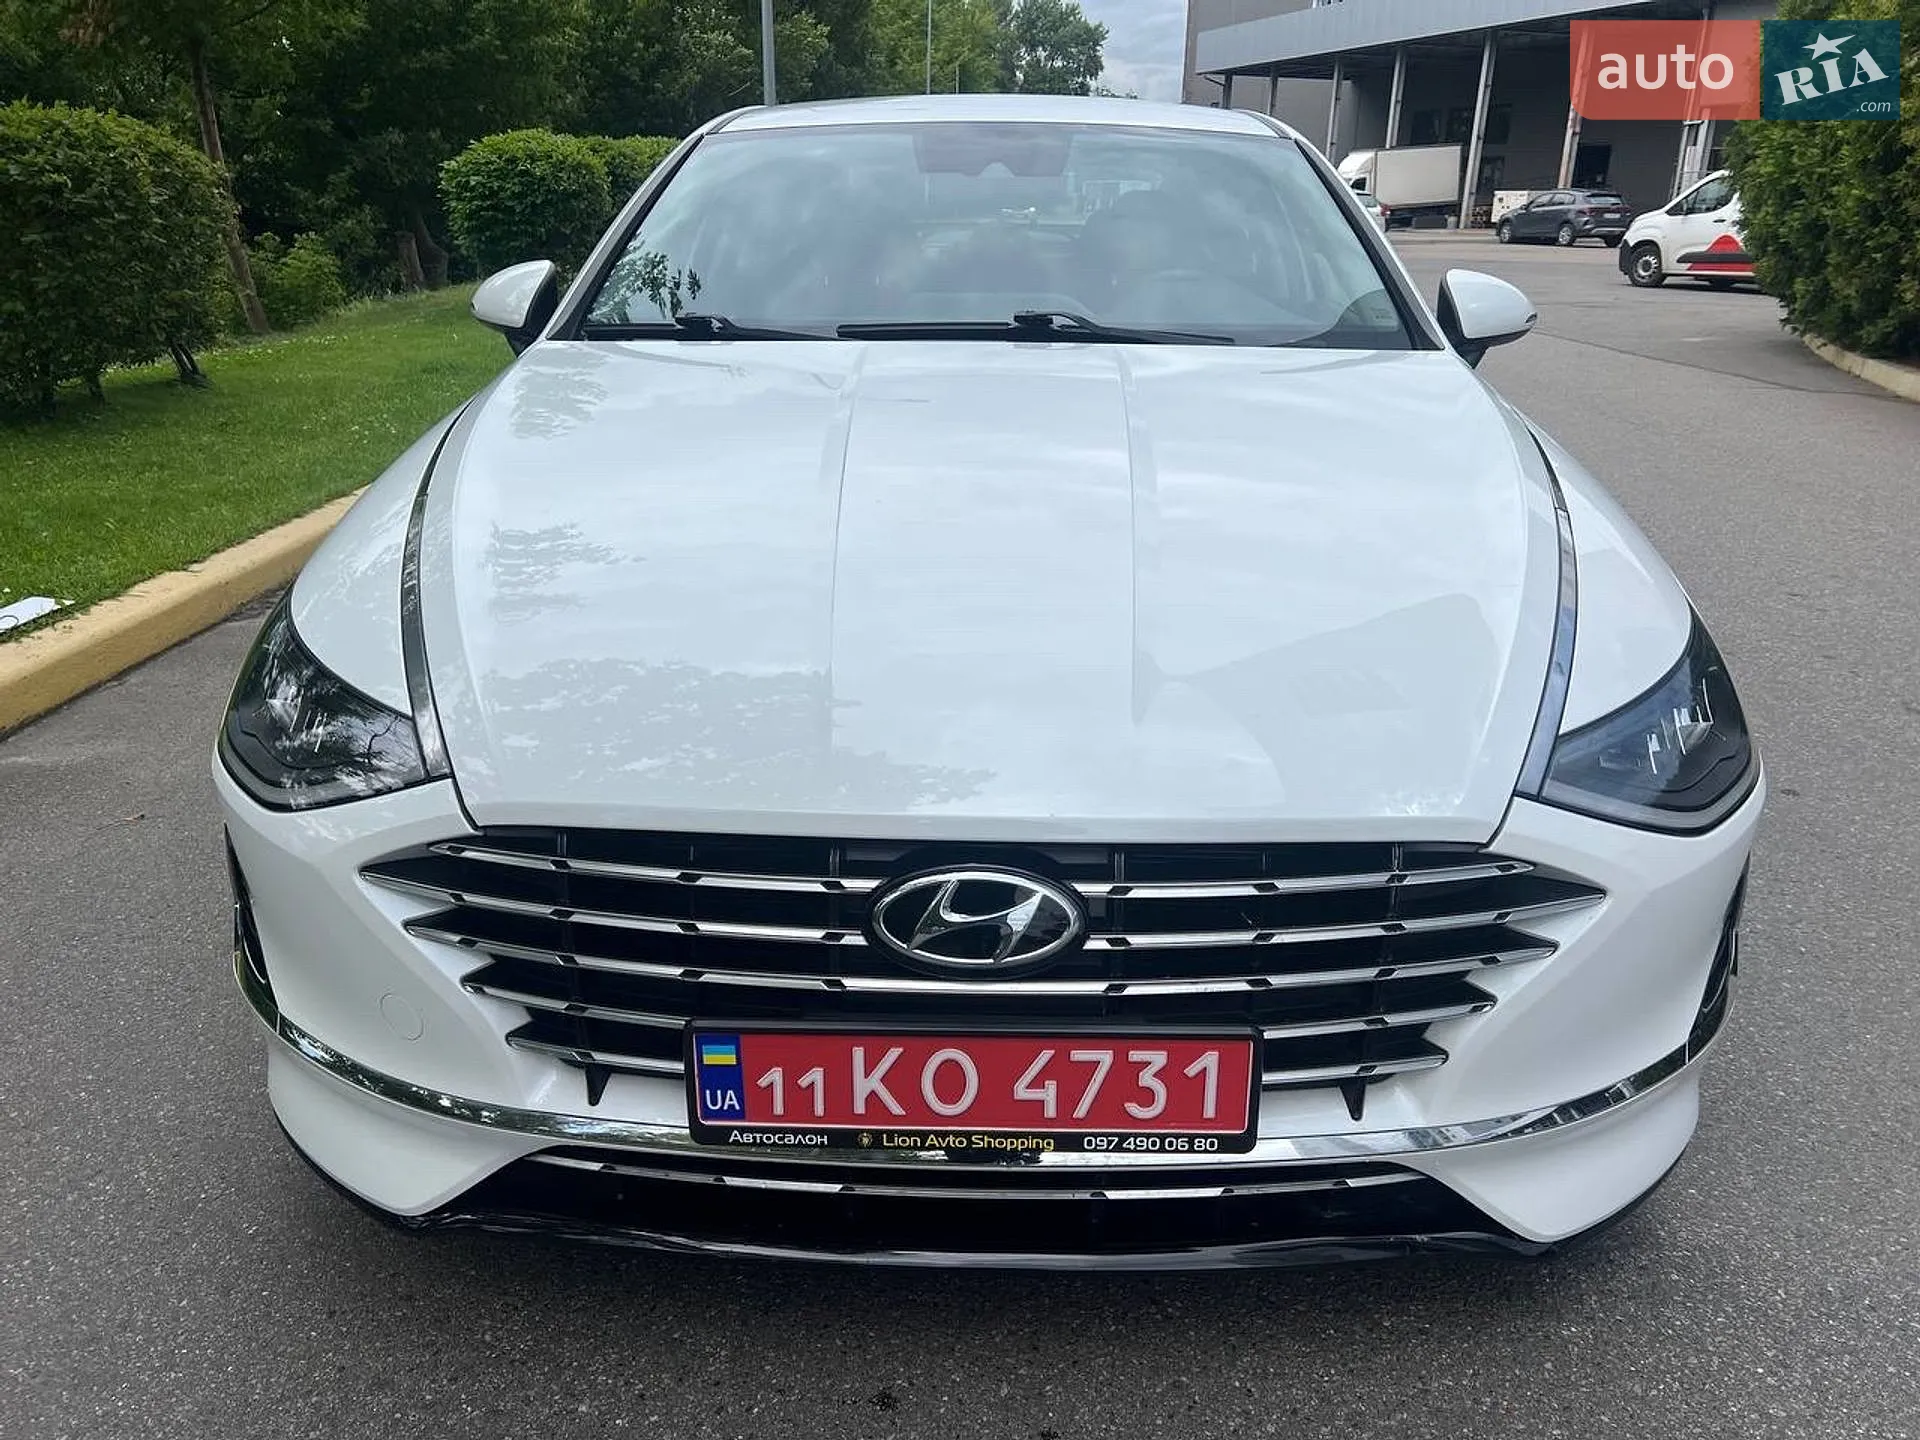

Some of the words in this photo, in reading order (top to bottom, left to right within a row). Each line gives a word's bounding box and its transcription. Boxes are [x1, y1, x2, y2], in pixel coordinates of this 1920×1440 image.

[756, 1067, 825, 1117] 11
[852, 1047, 980, 1116] KO
[1013, 1050, 1220, 1120] 4731
[706, 1089, 740, 1111] UA
[728, 1129, 828, 1146] Автосалон
[882, 1132, 920, 1148] Lion
[925, 1134, 967, 1149] Avto
[971, 1134, 1054, 1152] Shopping
[1083, 1136, 1118, 1150] 097
[1122, 1136, 1160, 1151] 490
[1164, 1137, 1189, 1151] 06
[1193, 1137, 1218, 1151] 80
